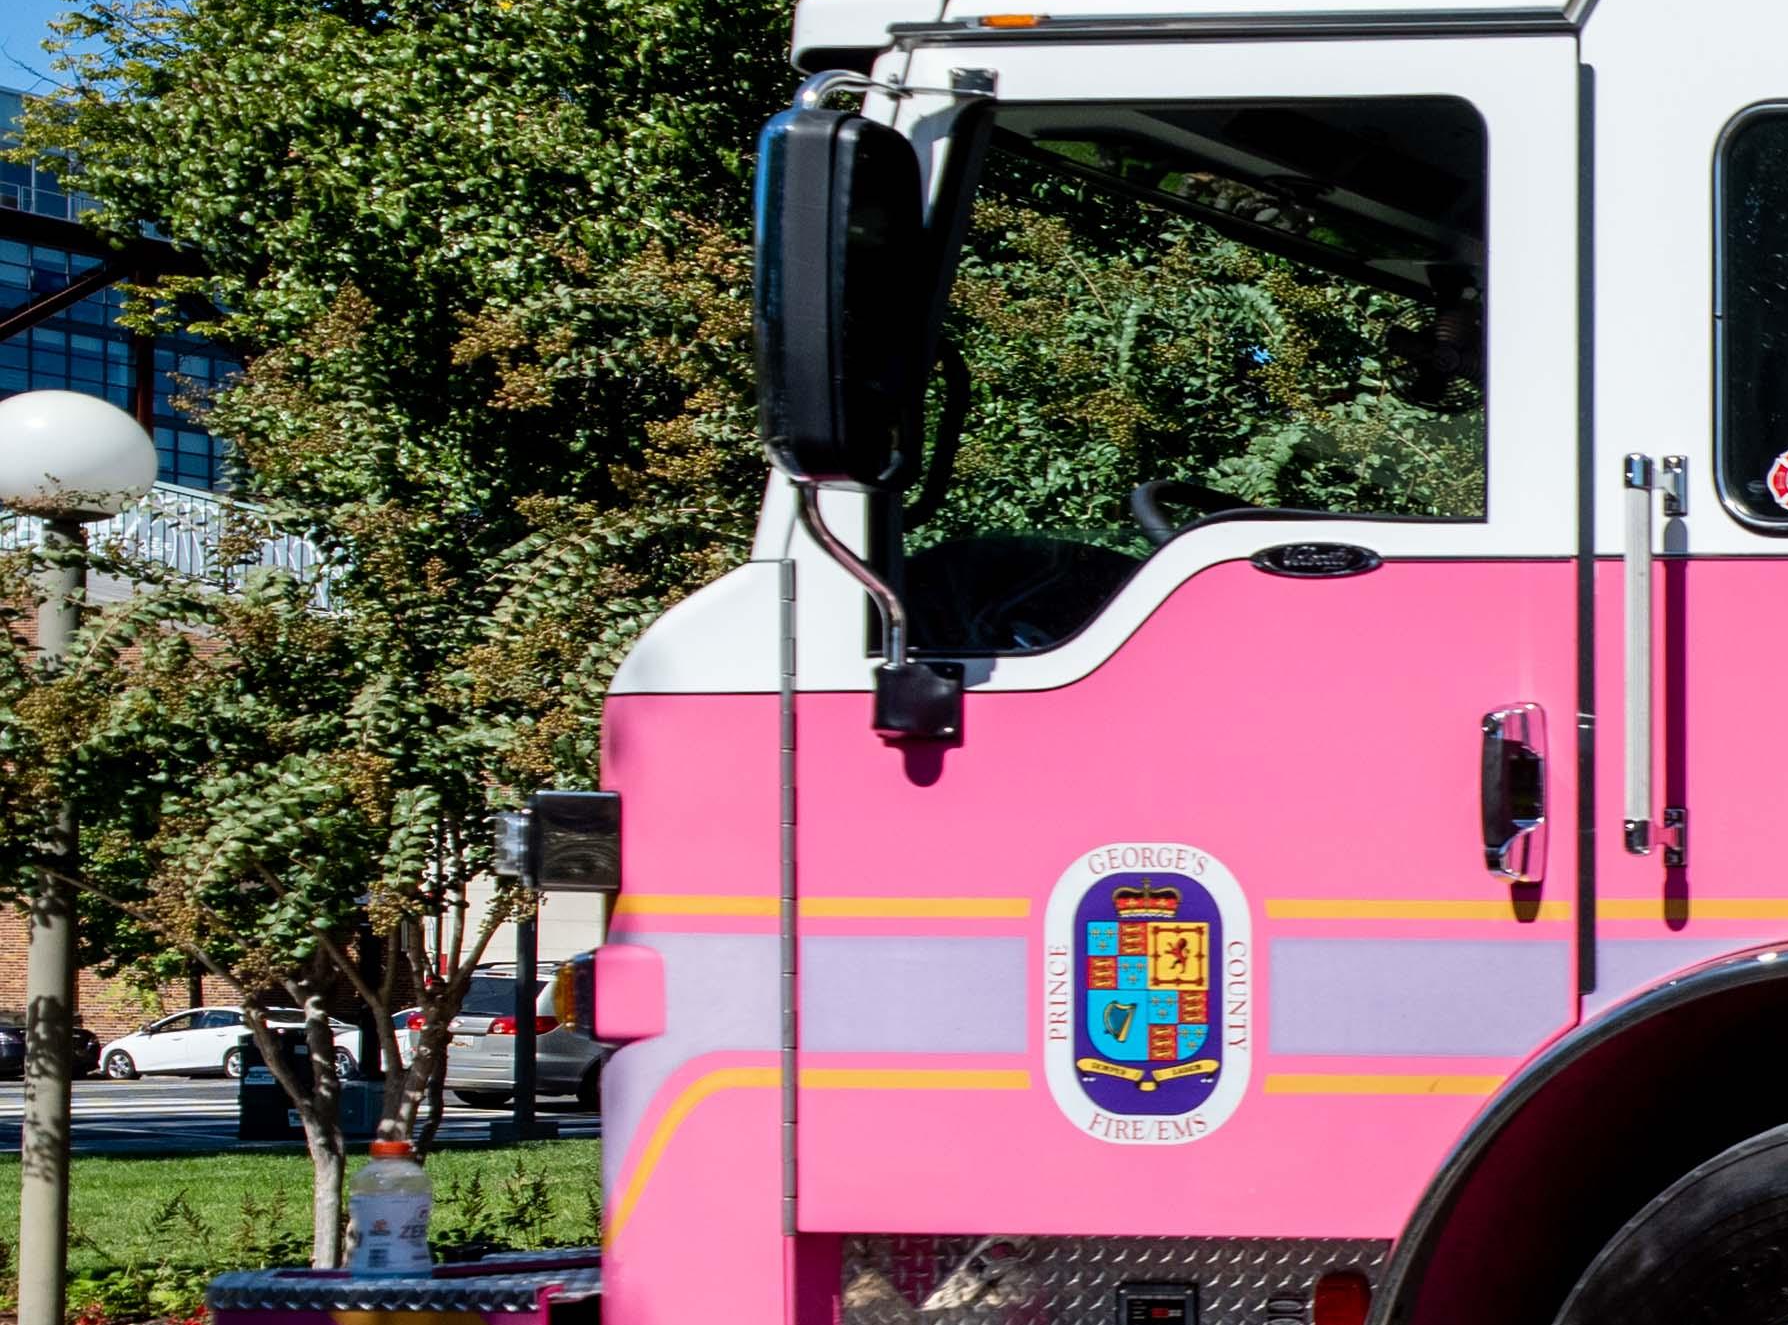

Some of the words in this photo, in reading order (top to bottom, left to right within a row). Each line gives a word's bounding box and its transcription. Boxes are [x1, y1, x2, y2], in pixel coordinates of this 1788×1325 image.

[1087, 846, 1210, 877] GEORGE'S
[1047, 943, 1069, 1042] PRINCE
[1226, 940, 1248, 1051] COUNTY
[1087, 1112, 1209, 1142] FIRE/EMS
